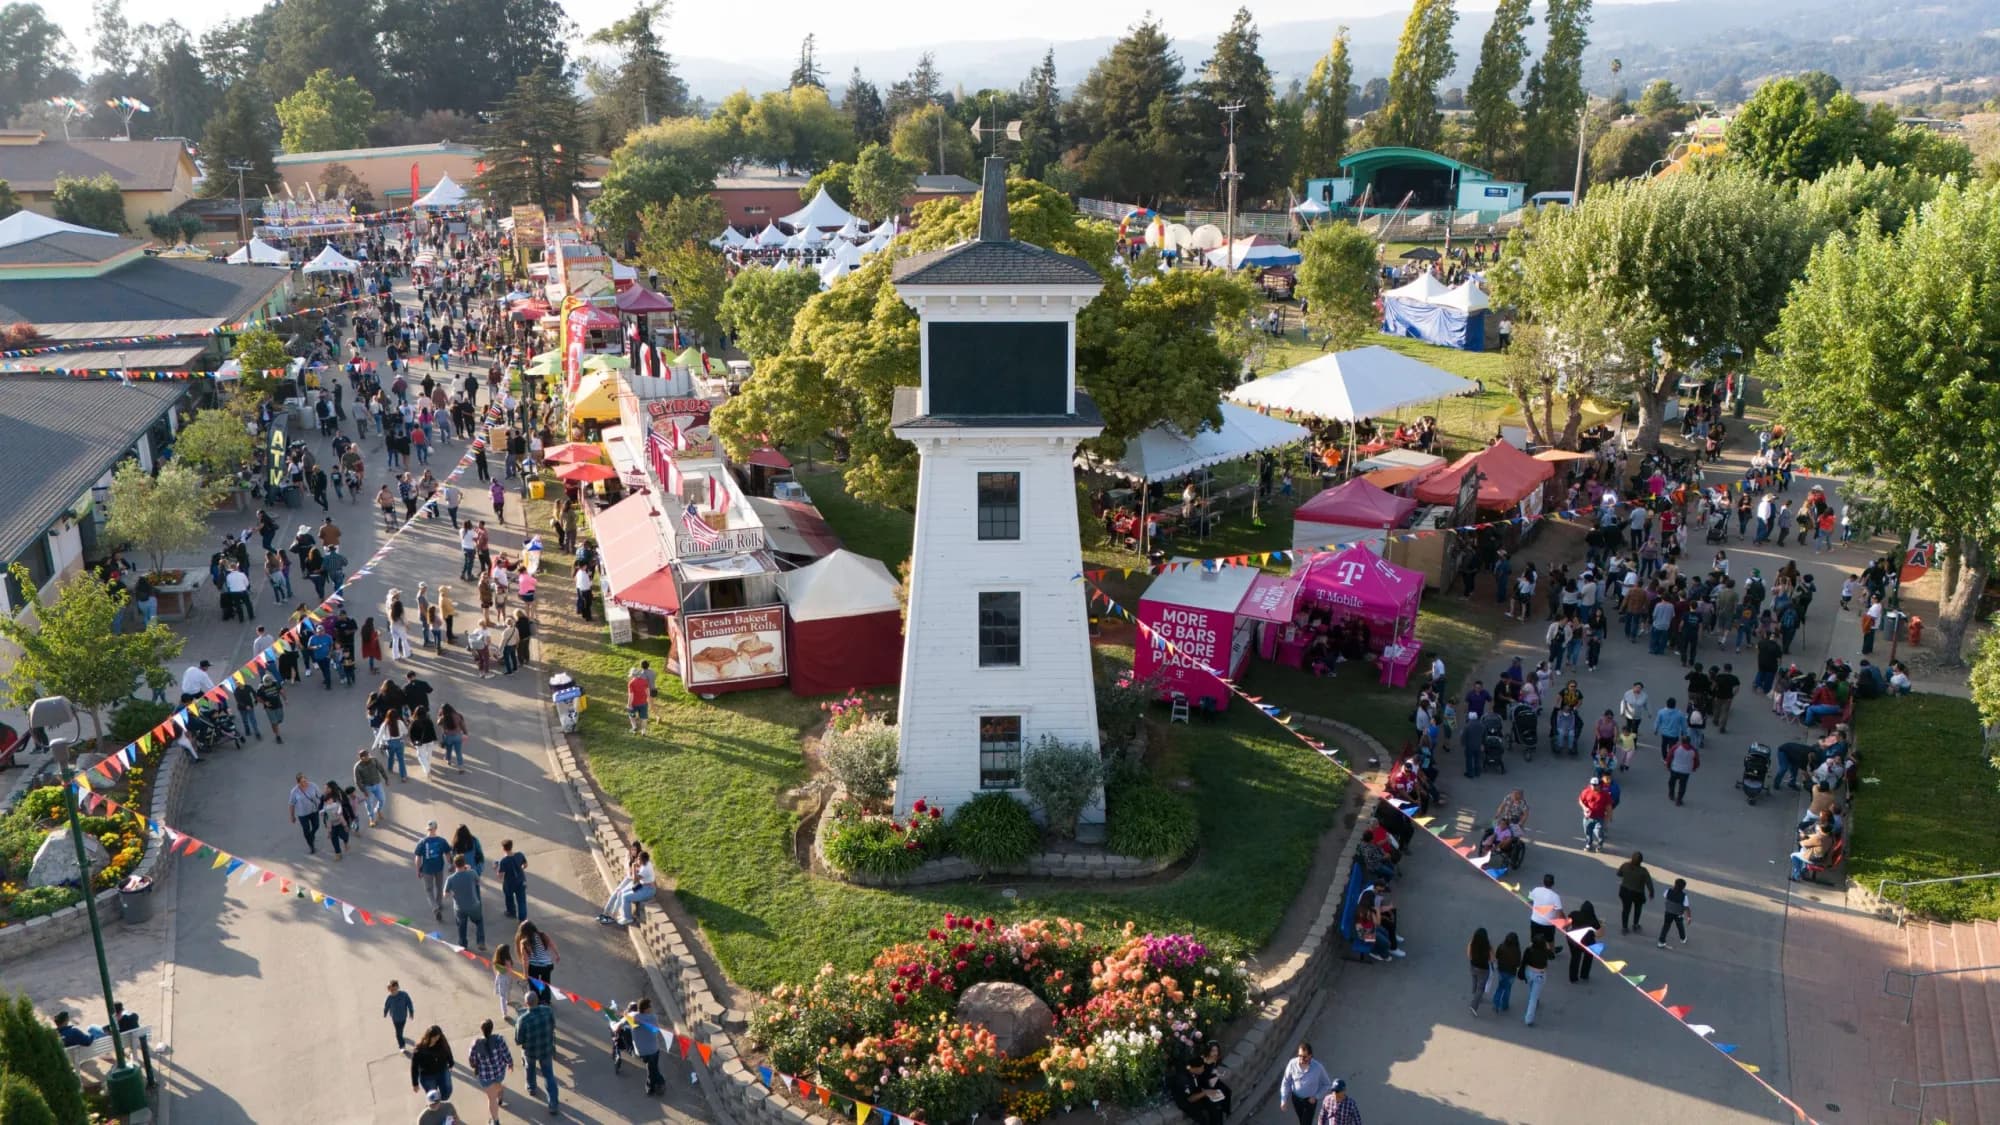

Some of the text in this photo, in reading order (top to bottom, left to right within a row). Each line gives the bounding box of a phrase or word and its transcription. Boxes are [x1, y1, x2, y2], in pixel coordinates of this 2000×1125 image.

[648, 398, 712, 416] GYROS
[269, 430, 284, 486] ATM
[736, 532, 763, 548] Rolls
[1337, 560, 1365, 586] T
[701, 613, 768, 630] Fresh Baked
[1162, 608, 1208, 627] MORE
[693, 622, 777, 638] Cinnamon Rolls
[1151, 622, 1216, 643] 5G BARS
[1170, 639, 1215, 658] MORE
[1152, 651, 1211, 671] PLACES
